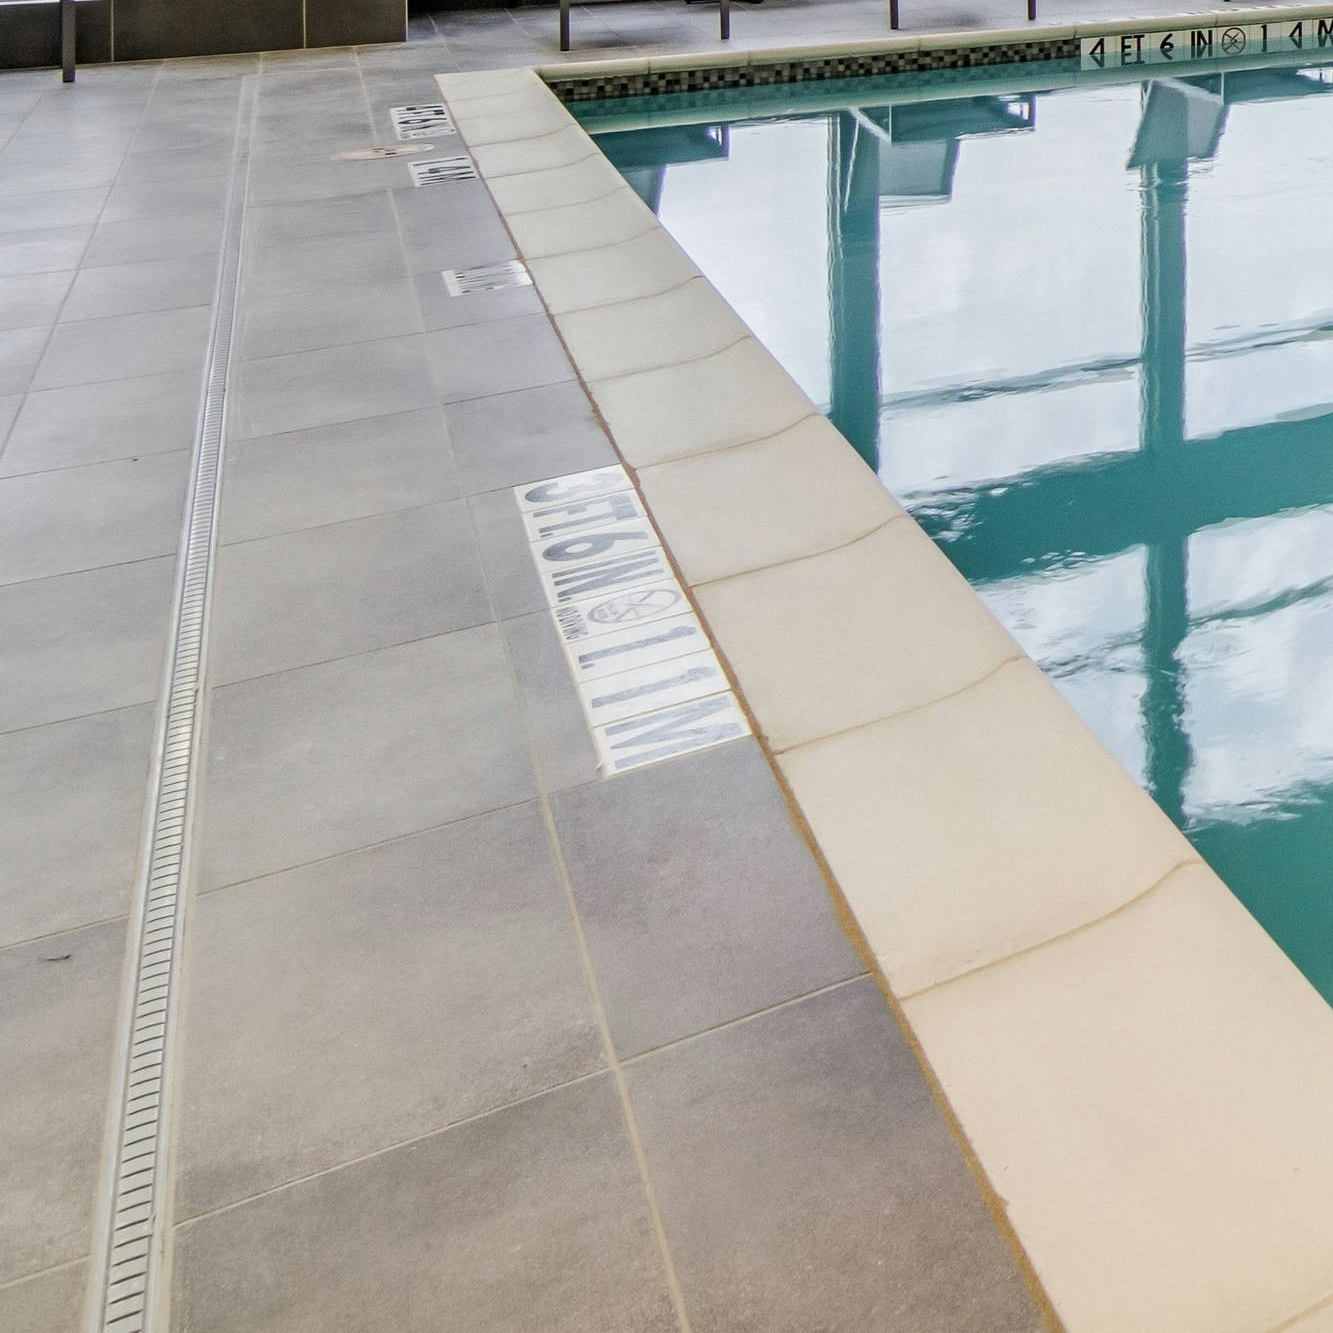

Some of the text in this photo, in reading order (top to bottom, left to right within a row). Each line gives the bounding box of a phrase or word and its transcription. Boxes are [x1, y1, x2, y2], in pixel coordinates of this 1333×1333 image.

[1121, 34, 1145, 52] FT
[1160, 33, 1174, 50] 6
[1191, 30, 1213, 46] IN
[1261, 25, 1268, 40] 1
[525, 472, 624, 503] 3
[533, 493, 638, 538] FT.
[542, 531, 648, 561] 6
[552, 550, 664, 602] IN.
[605, 696, 744, 769] M
